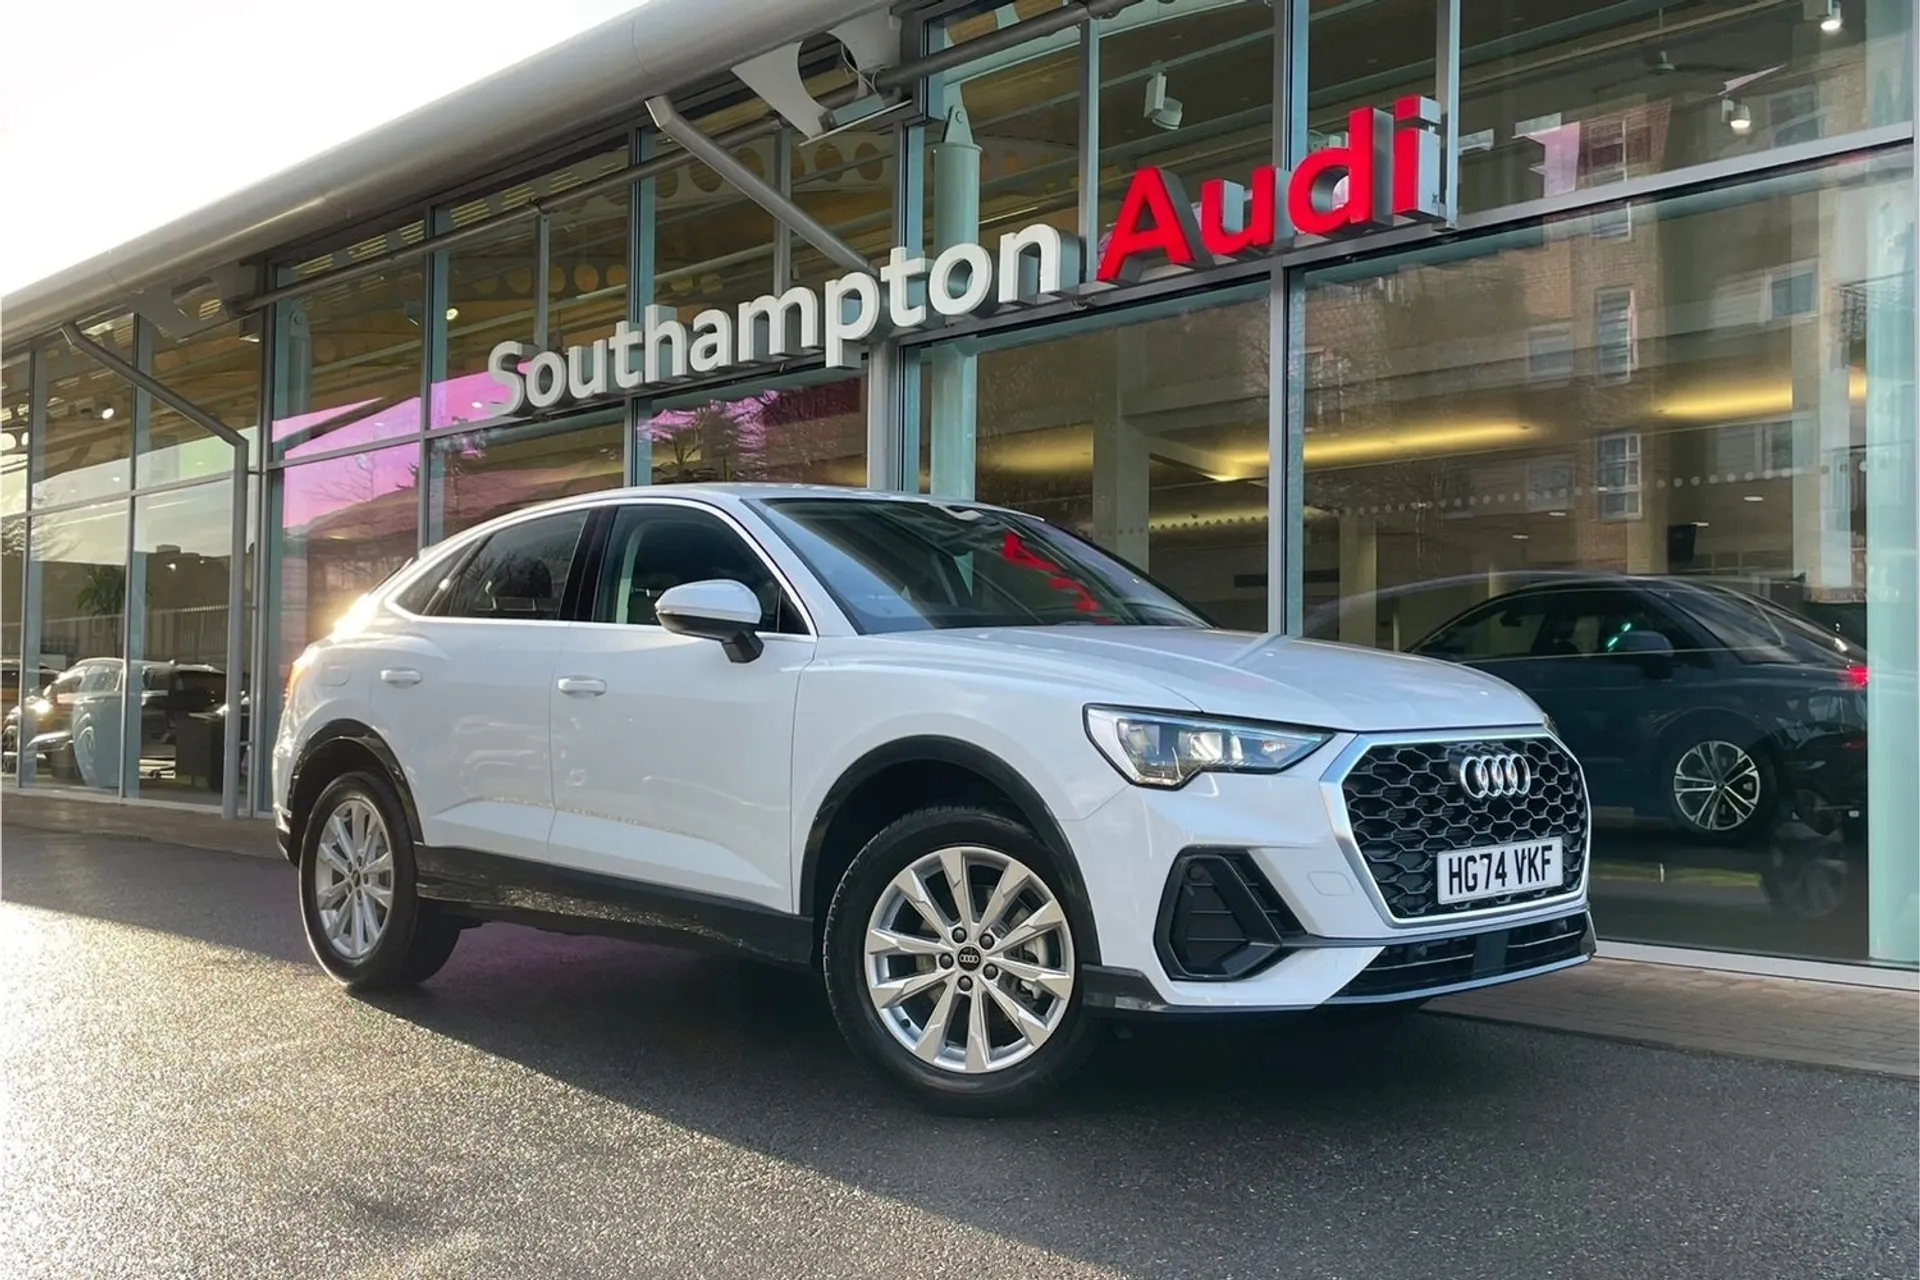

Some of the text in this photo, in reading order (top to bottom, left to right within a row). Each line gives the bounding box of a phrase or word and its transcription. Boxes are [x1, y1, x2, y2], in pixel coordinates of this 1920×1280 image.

[487, 94, 1421, 418] Southampton Audi
[1449, 845, 1553, 895] HG74 VKF
